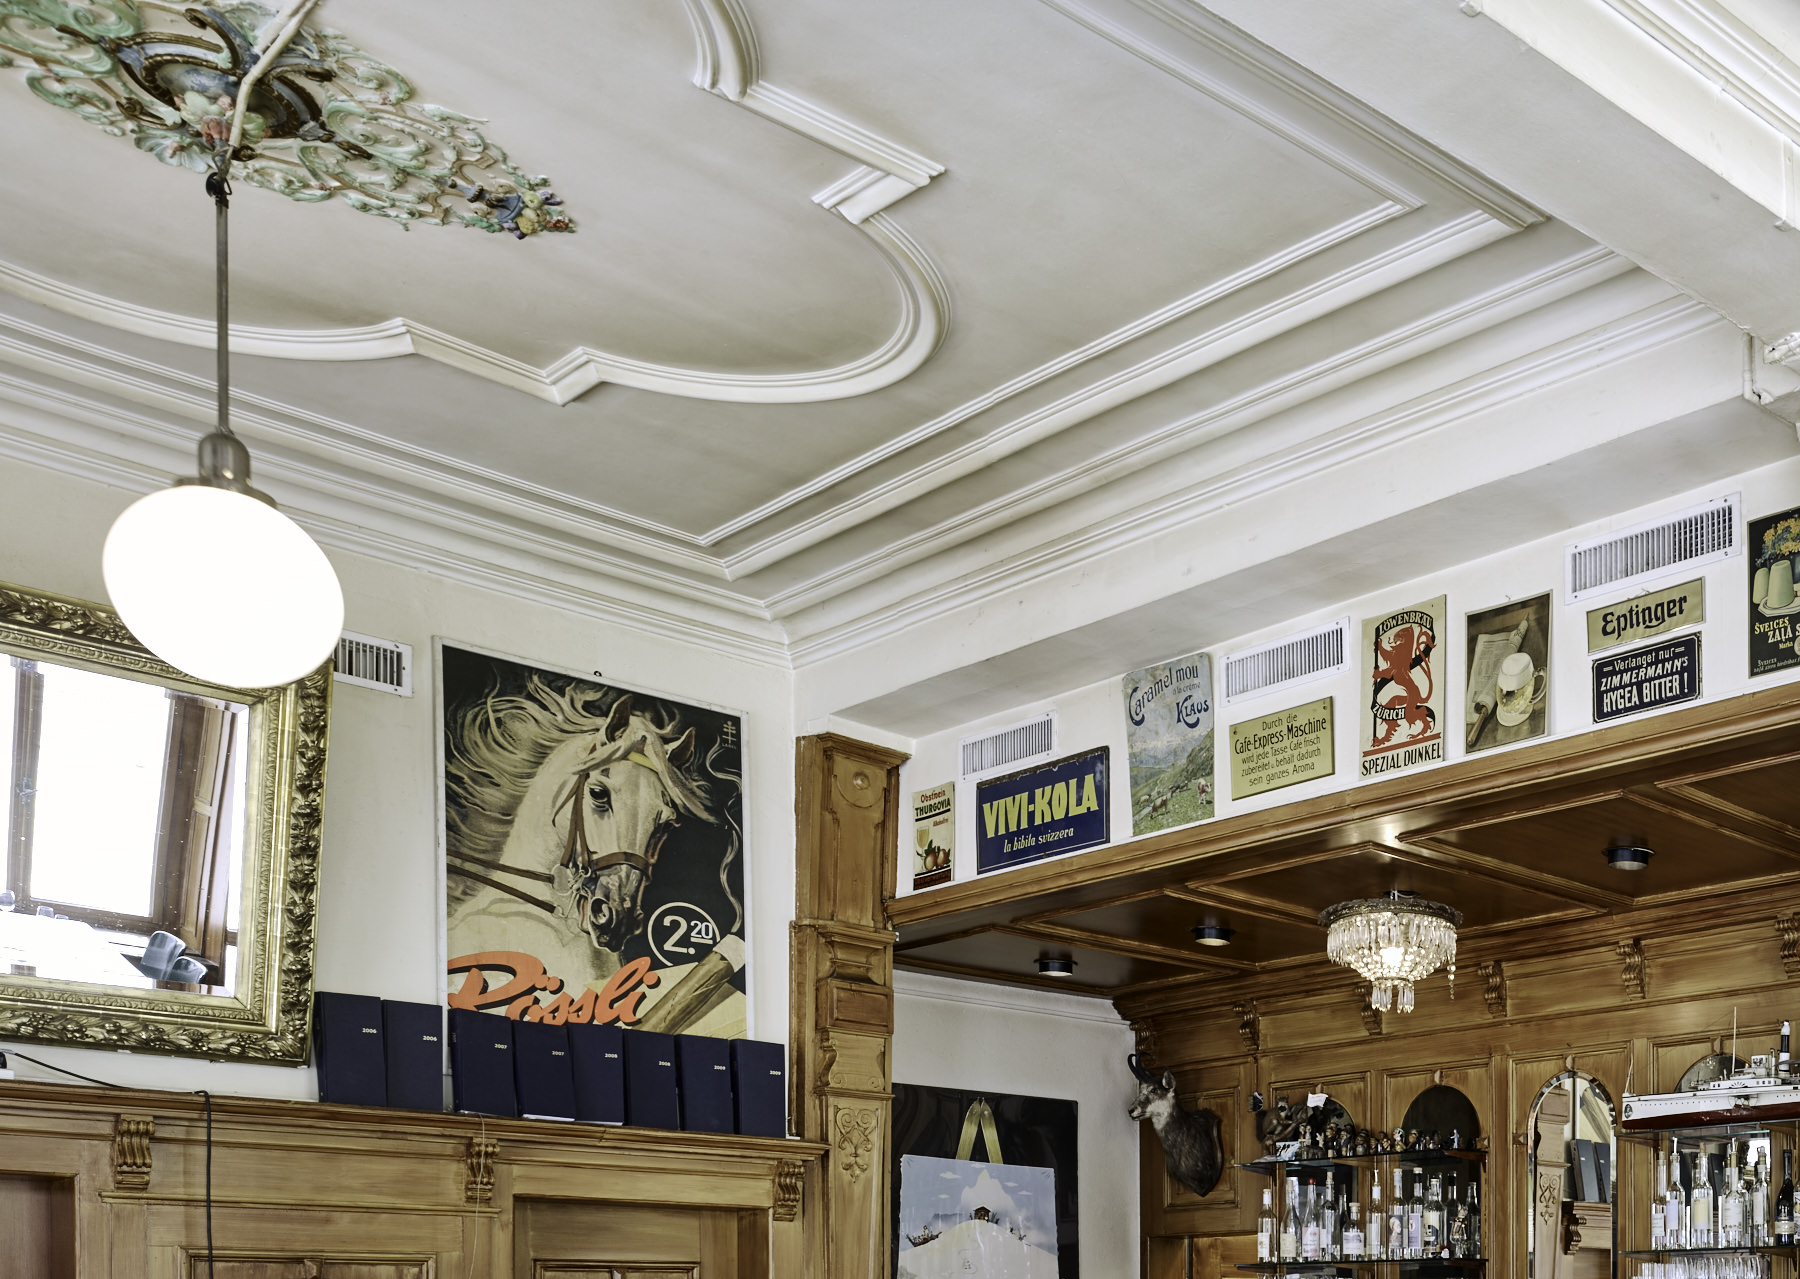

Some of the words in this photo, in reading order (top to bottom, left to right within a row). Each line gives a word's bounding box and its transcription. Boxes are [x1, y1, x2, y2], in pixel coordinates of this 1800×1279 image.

[1378, 611, 1433, 637] LÖWENBRÄU
[1601, 595, 1688, 640] Eptinger
[1614, 651, 1656, 671] Verlanget
[1658, 647, 1674, 660] nur
[1128, 666, 1173, 727] Caramel
[1175, 664, 1199, 683] mou
[1603, 685, 1639, 713] HYGEA
[1262, 716, 1283, 731] Durch
[1286, 713, 1298, 724] die
[1372, 702, 1406, 720] ZÜRICH
[1241, 752, 1254, 764] wird
[1255, 749, 1270, 764] jede
[1271, 746, 1288, 758] Tasse
[1303, 735, 1321, 748] frisch
[1241, 761, 1270, 777] zubereitet
[1296, 747, 1321, 762] dadurch
[1361, 753, 1402, 777] SPEZIAL
[1403, 742, 1442, 767] DUNKEL
[1249, 774, 1263, 787] sein
[1265, 768, 1290, 785] ganzes
[1292, 762, 1315, 775] Aroma
[915, 798, 951, 817] THURGOVIA
[982, 773, 1099, 839] VIVI-KOLA
[1003, 839, 1011, 853] la
[1038, 827, 1074, 844] svizzera
